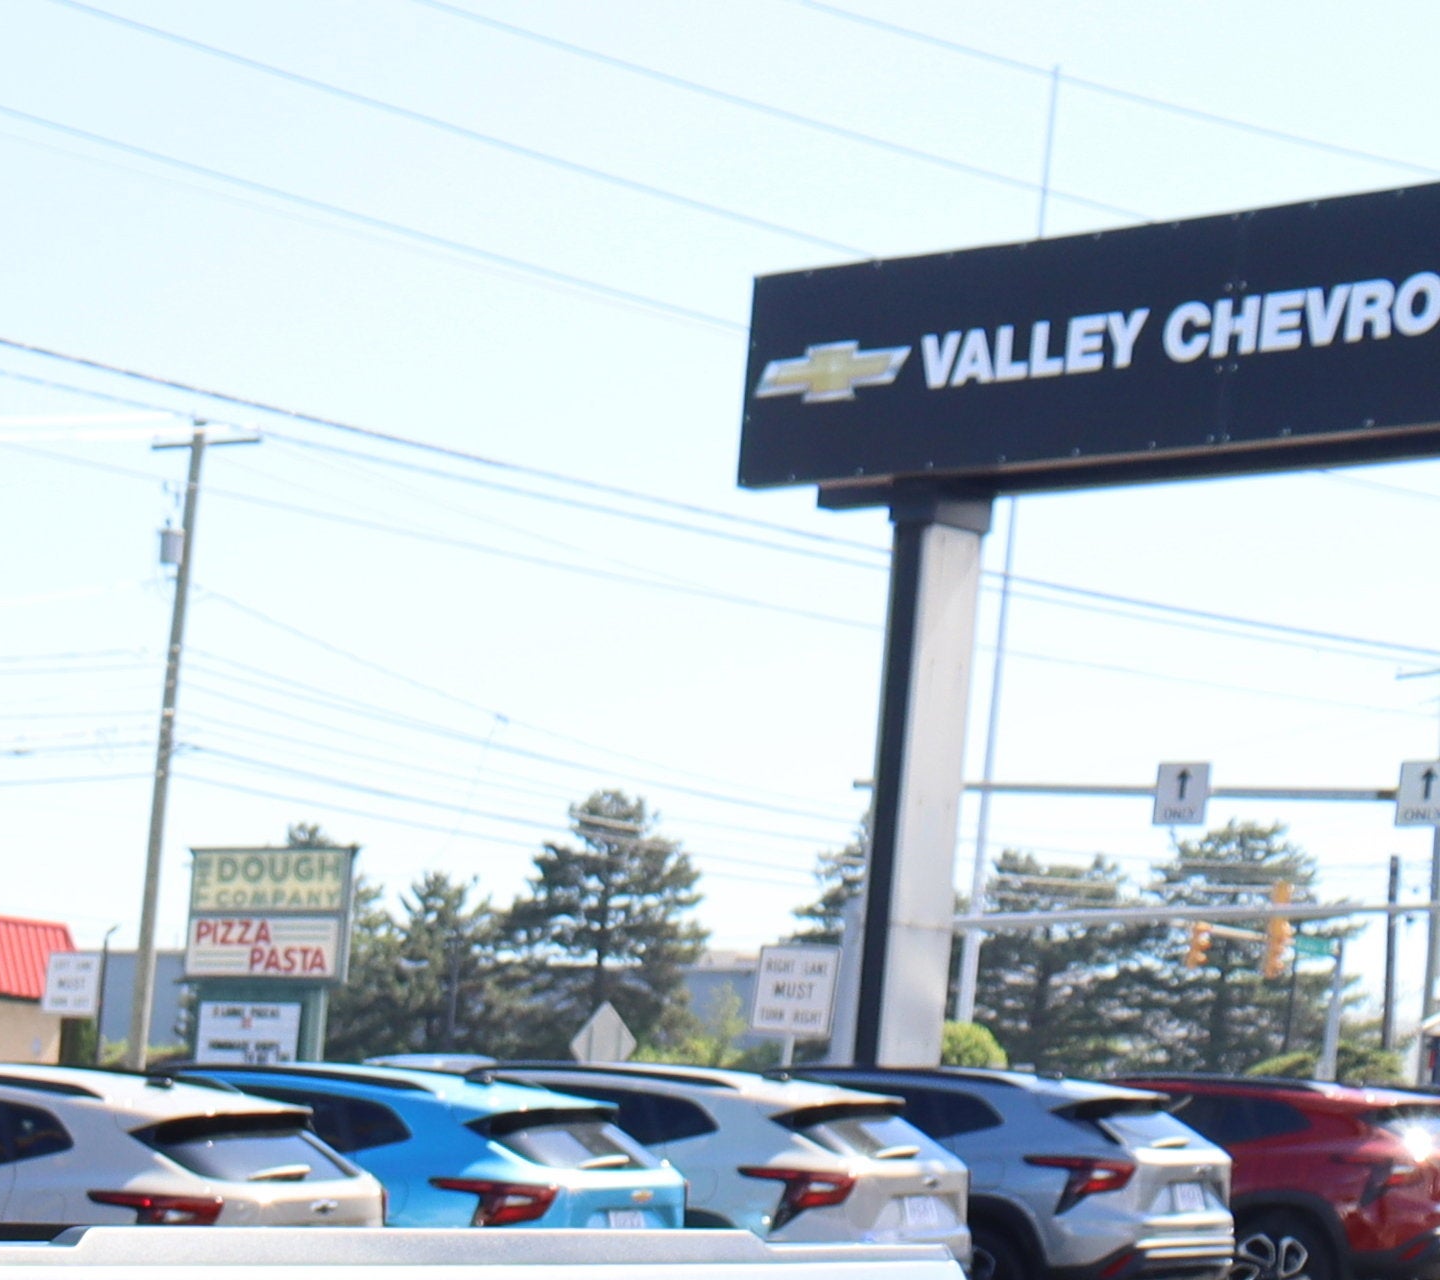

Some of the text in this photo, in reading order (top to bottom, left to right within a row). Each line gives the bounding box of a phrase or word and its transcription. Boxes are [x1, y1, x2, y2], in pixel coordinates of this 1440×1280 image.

[921, 308, 1149, 389] VALLEY
[1164, 807, 1195, 820] ONLY
[217, 856, 341, 883] DOUGH
[215, 888, 340, 906] COMPANY
[196, 919, 272, 945] PIZZA
[250, 947, 326, 972] PASTA
[772, 980, 815, 999] MUST
